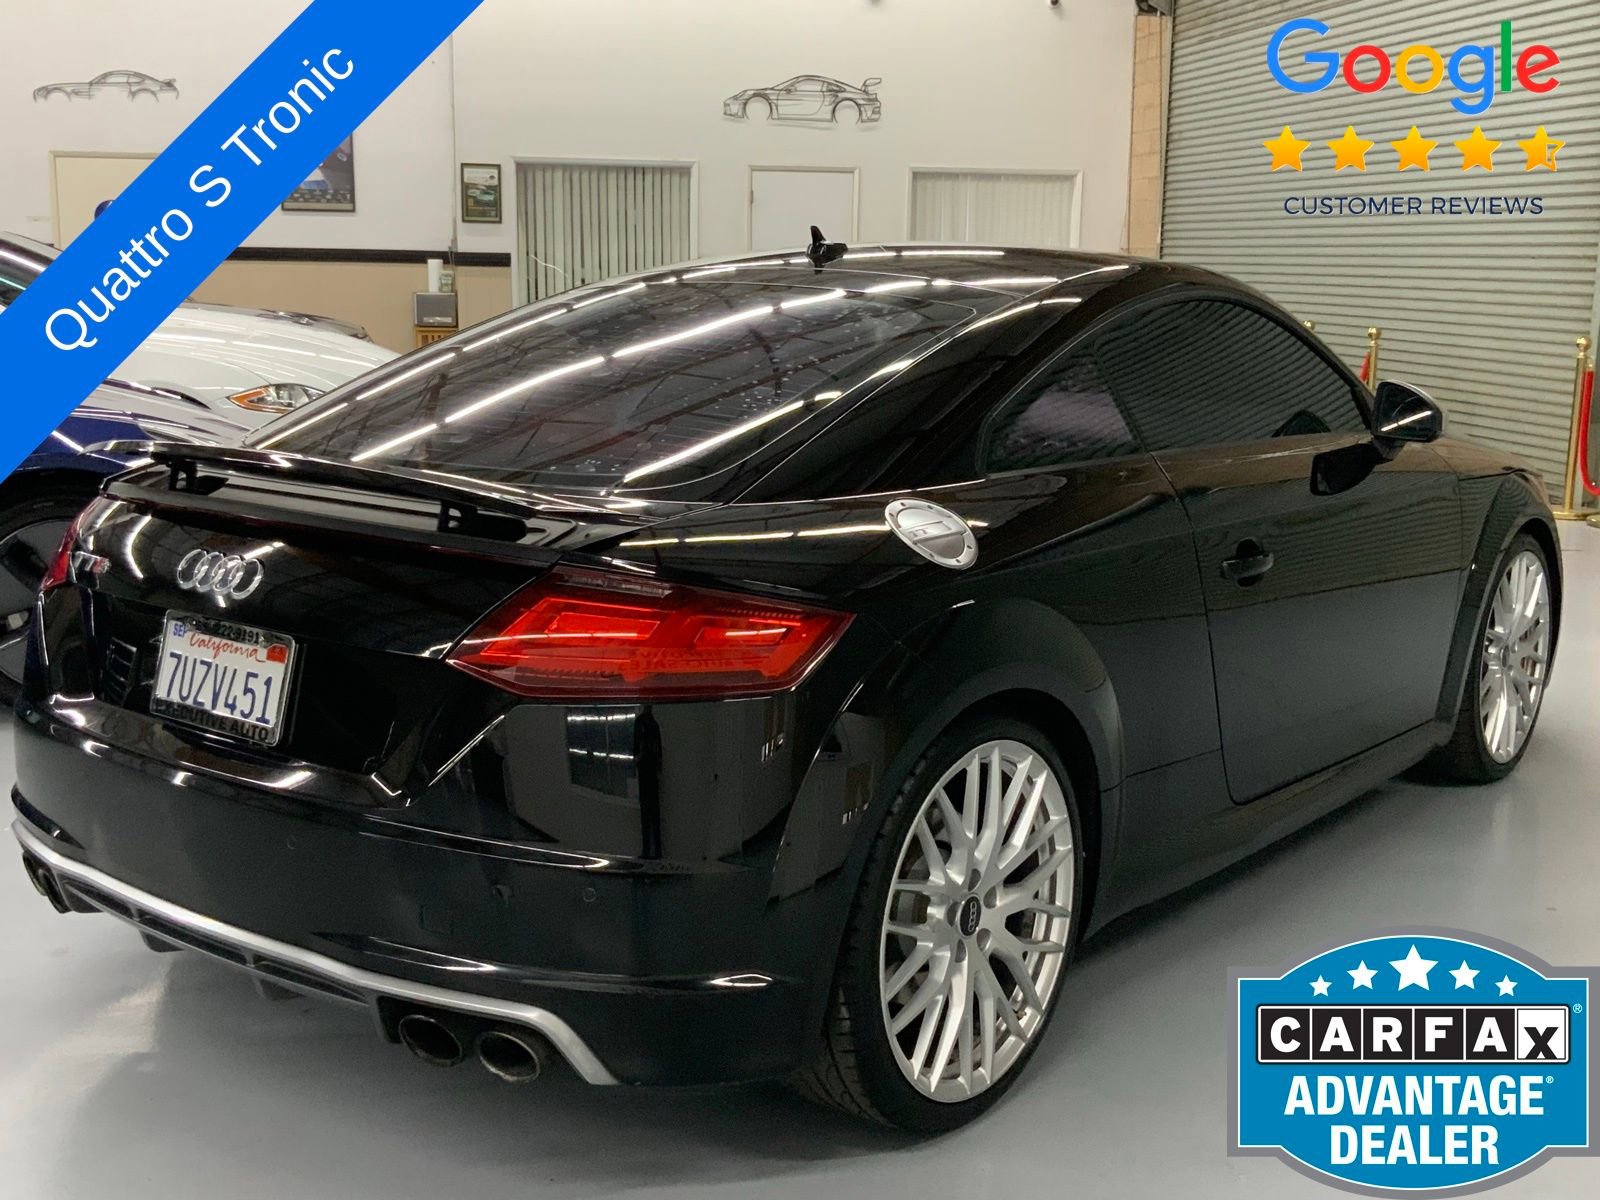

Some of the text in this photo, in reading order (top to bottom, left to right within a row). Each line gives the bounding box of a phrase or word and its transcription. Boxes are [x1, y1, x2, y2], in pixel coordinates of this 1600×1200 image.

[189, 632, 266, 662] California
[166, 652, 272, 724] 7UZV451
[230, 721, 270, 741] AUTO
